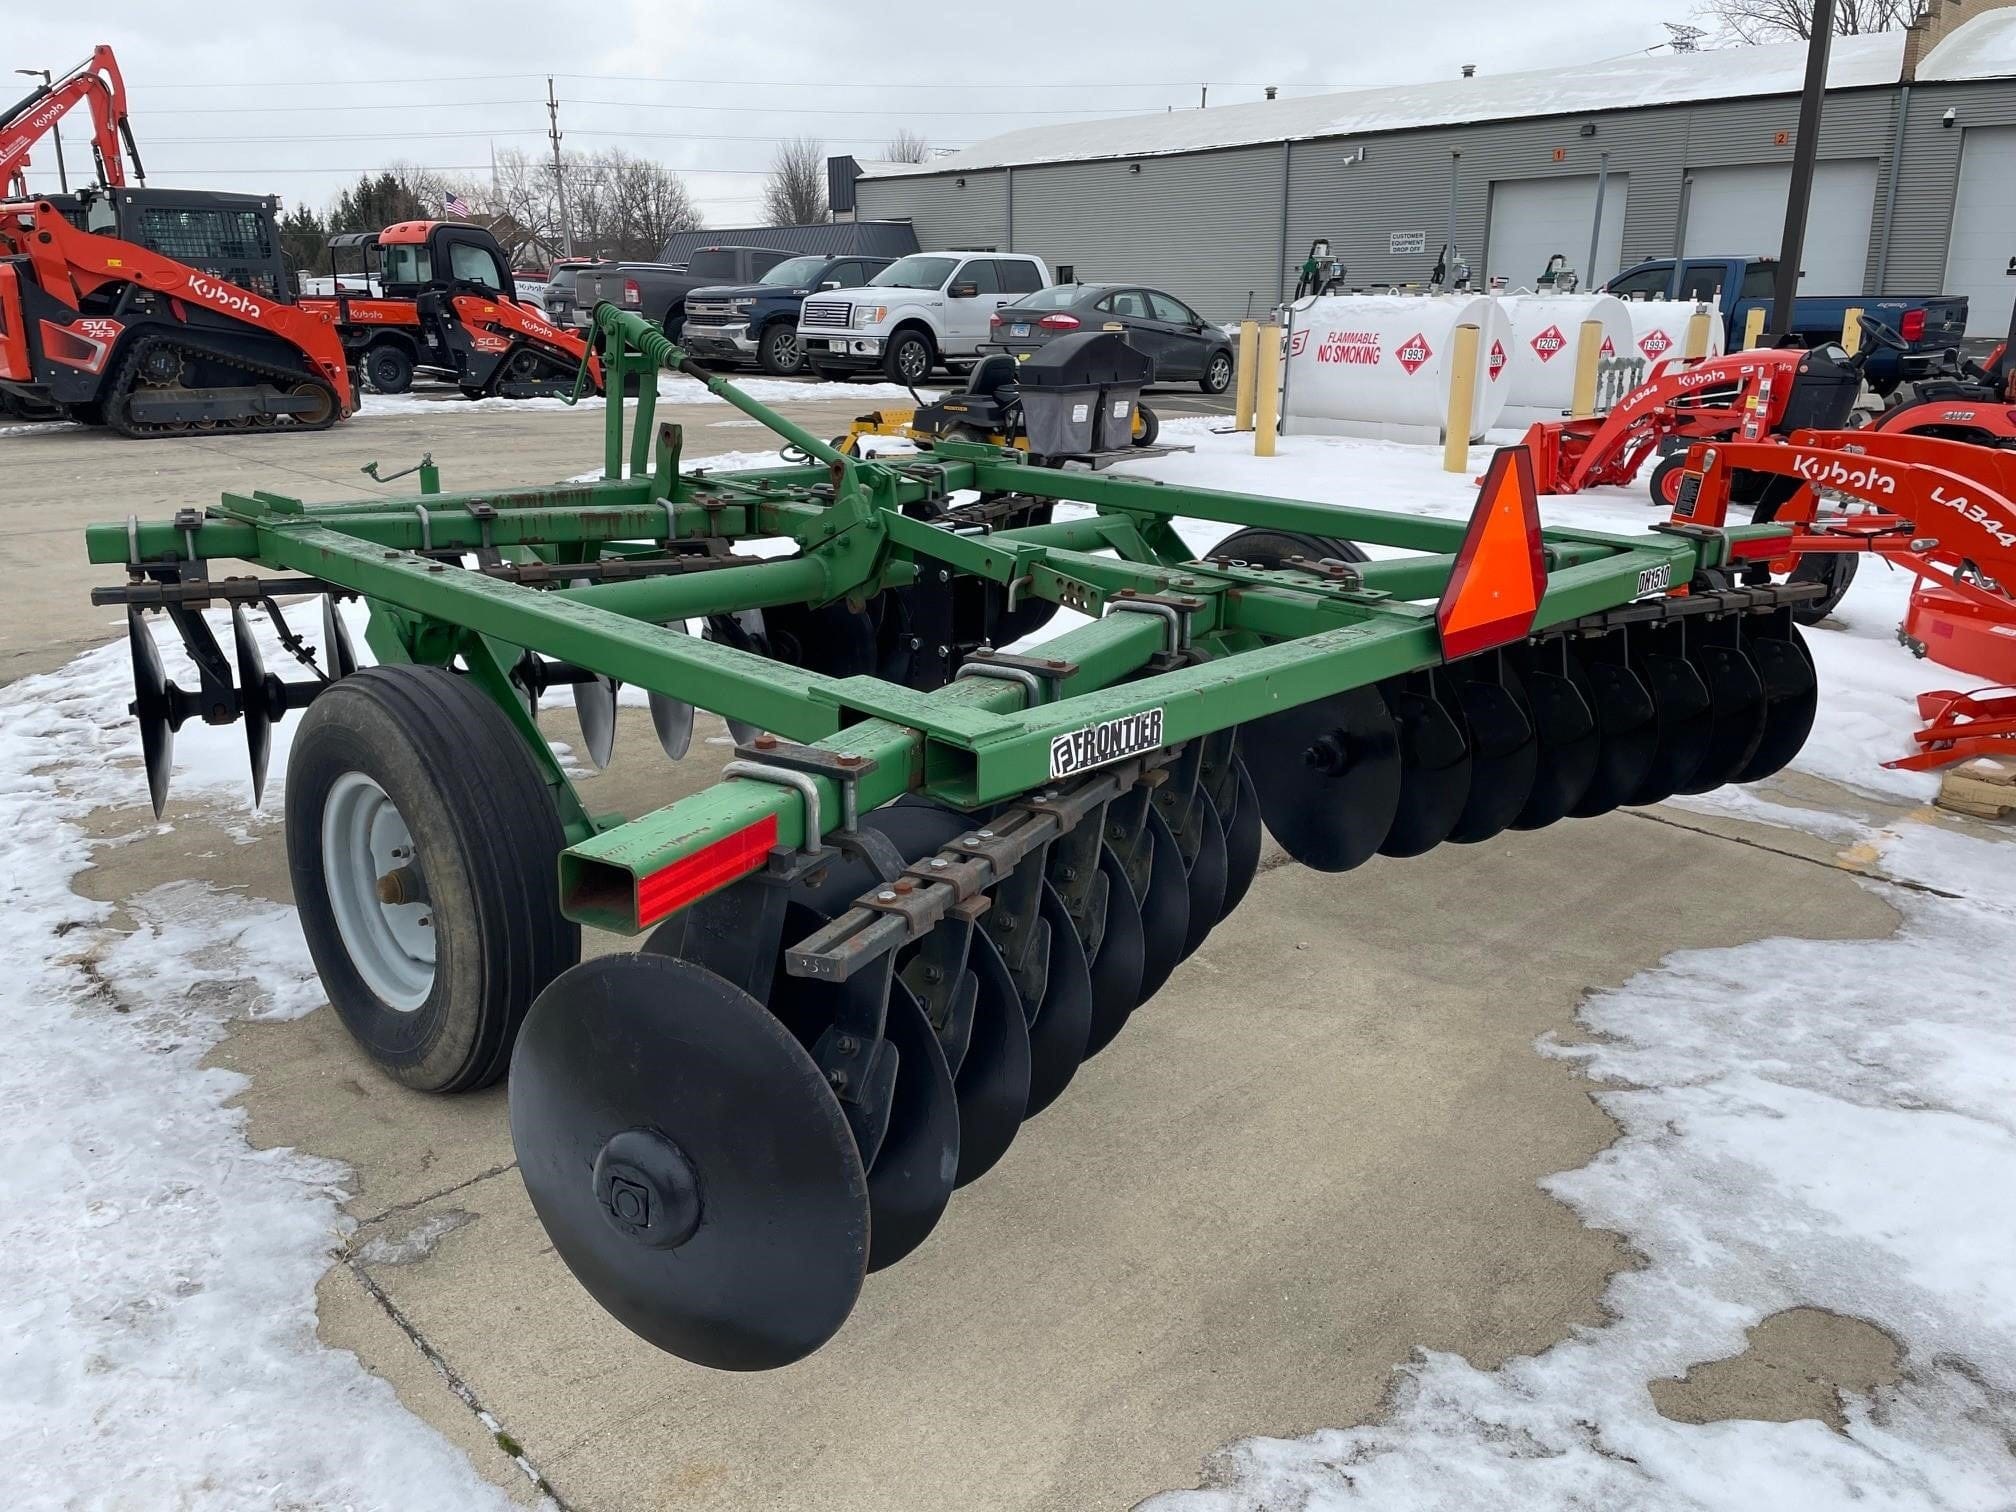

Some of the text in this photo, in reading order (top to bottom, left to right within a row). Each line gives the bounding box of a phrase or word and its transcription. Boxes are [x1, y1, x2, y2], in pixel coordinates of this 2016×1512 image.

[33, 104, 64, 128] Kubota
[1778, 133, 1785, 144] 2
[189, 274, 261, 318] Kubota
[350, 309, 383, 320] Kubota
[81, 321, 113, 330] SVL
[89, 330, 116, 338] 75-3
[521, 318, 553, 338] Kubota
[477, 337, 502, 346] SCL
[1328, 332, 1379, 344] FLAMMABLE
[1539, 338, 1559, 349] 1203
[1645, 340, 1665, 350] 1993
[1317, 345, 1332, 363] NO
[1333, 346, 1381, 365] SMOKING
[1403, 349, 1424, 361] 1993
[1678, 370, 1726, 387] Kubota
[1623, 385, 1657, 411] LA344
[1793, 454, 1896, 494] Kubota
[1930, 486, 2016, 547] LA344
[1638, 565, 1670, 593] DH1510
[1072, 710, 1161, 765] FRONTIER
